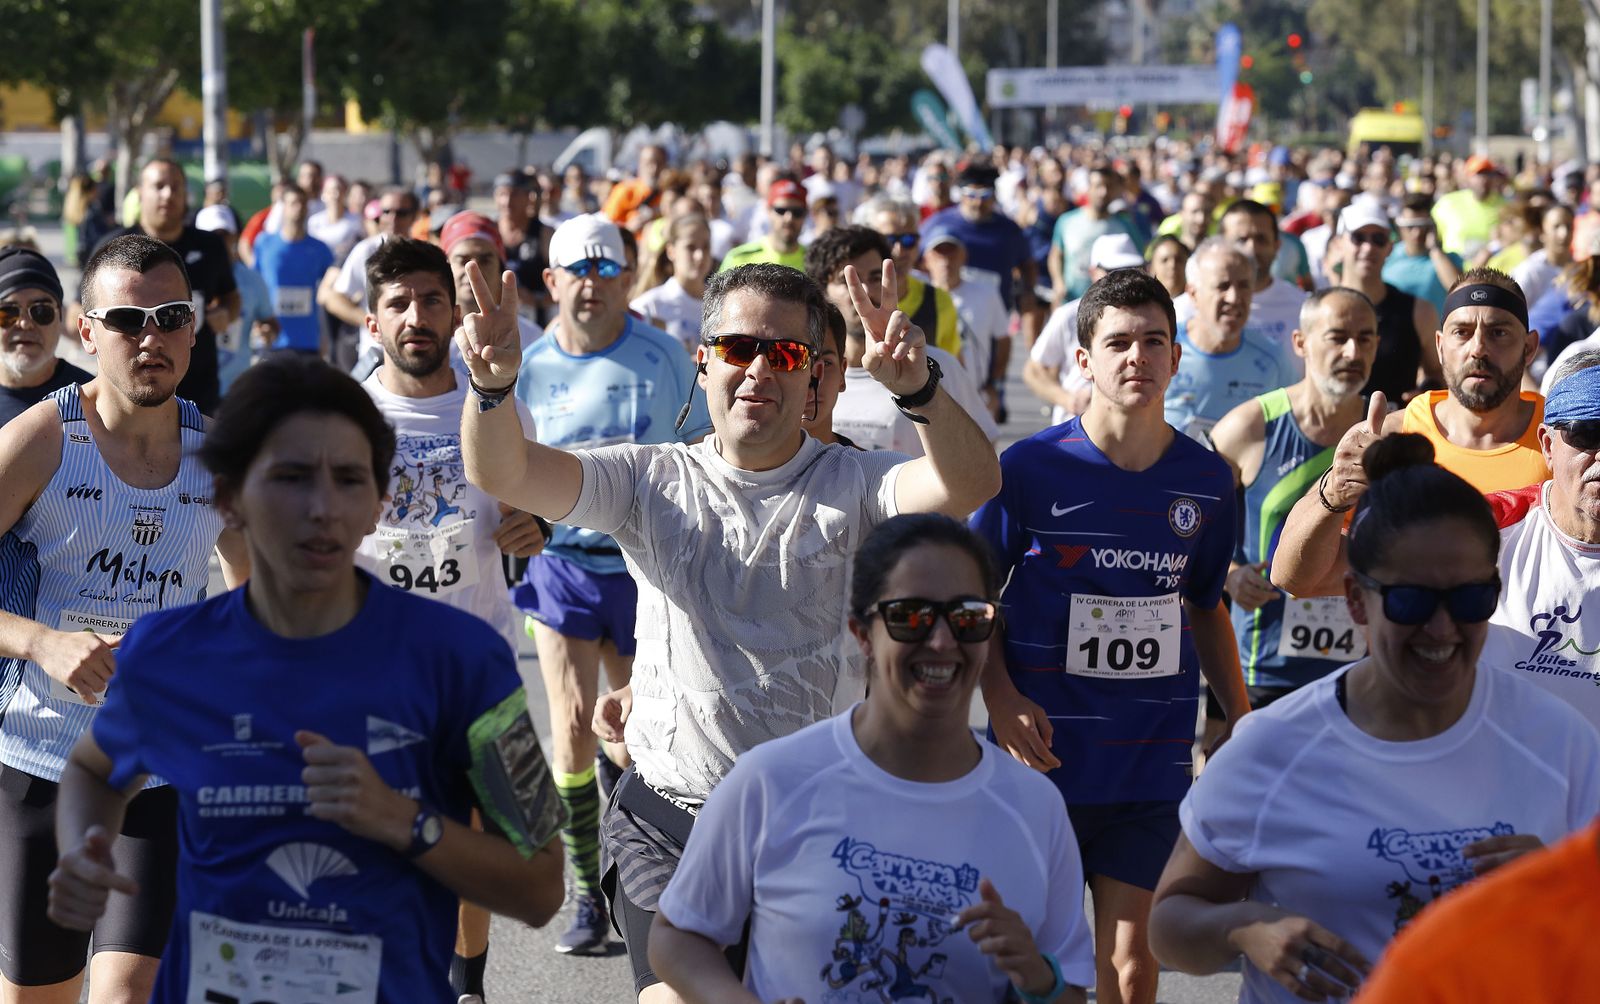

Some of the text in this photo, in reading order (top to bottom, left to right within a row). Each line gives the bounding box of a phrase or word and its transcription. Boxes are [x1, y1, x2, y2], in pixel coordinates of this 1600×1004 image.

[86, 548, 183, 610] Málaga
[389, 558, 461, 593] 943
[79, 588, 157, 606] Ciudad Genial
[1086, 598, 1125, 607] CARRERA
[1126, 600, 1137, 608] DE
[1149, 598, 1174, 607] PRENSA
[77, 616, 119, 629] CARRERA
[1290, 624, 1355, 655] 904
[1079, 636, 1160, 671] 109
[197, 785, 309, 805] CARRER
[268, 900, 348, 924] Unicaja
[212, 921, 270, 944] CARRERA
[272, 935, 291, 946] DE
[294, 937, 312, 948] LA
[315, 938, 370, 953] PRENSA
